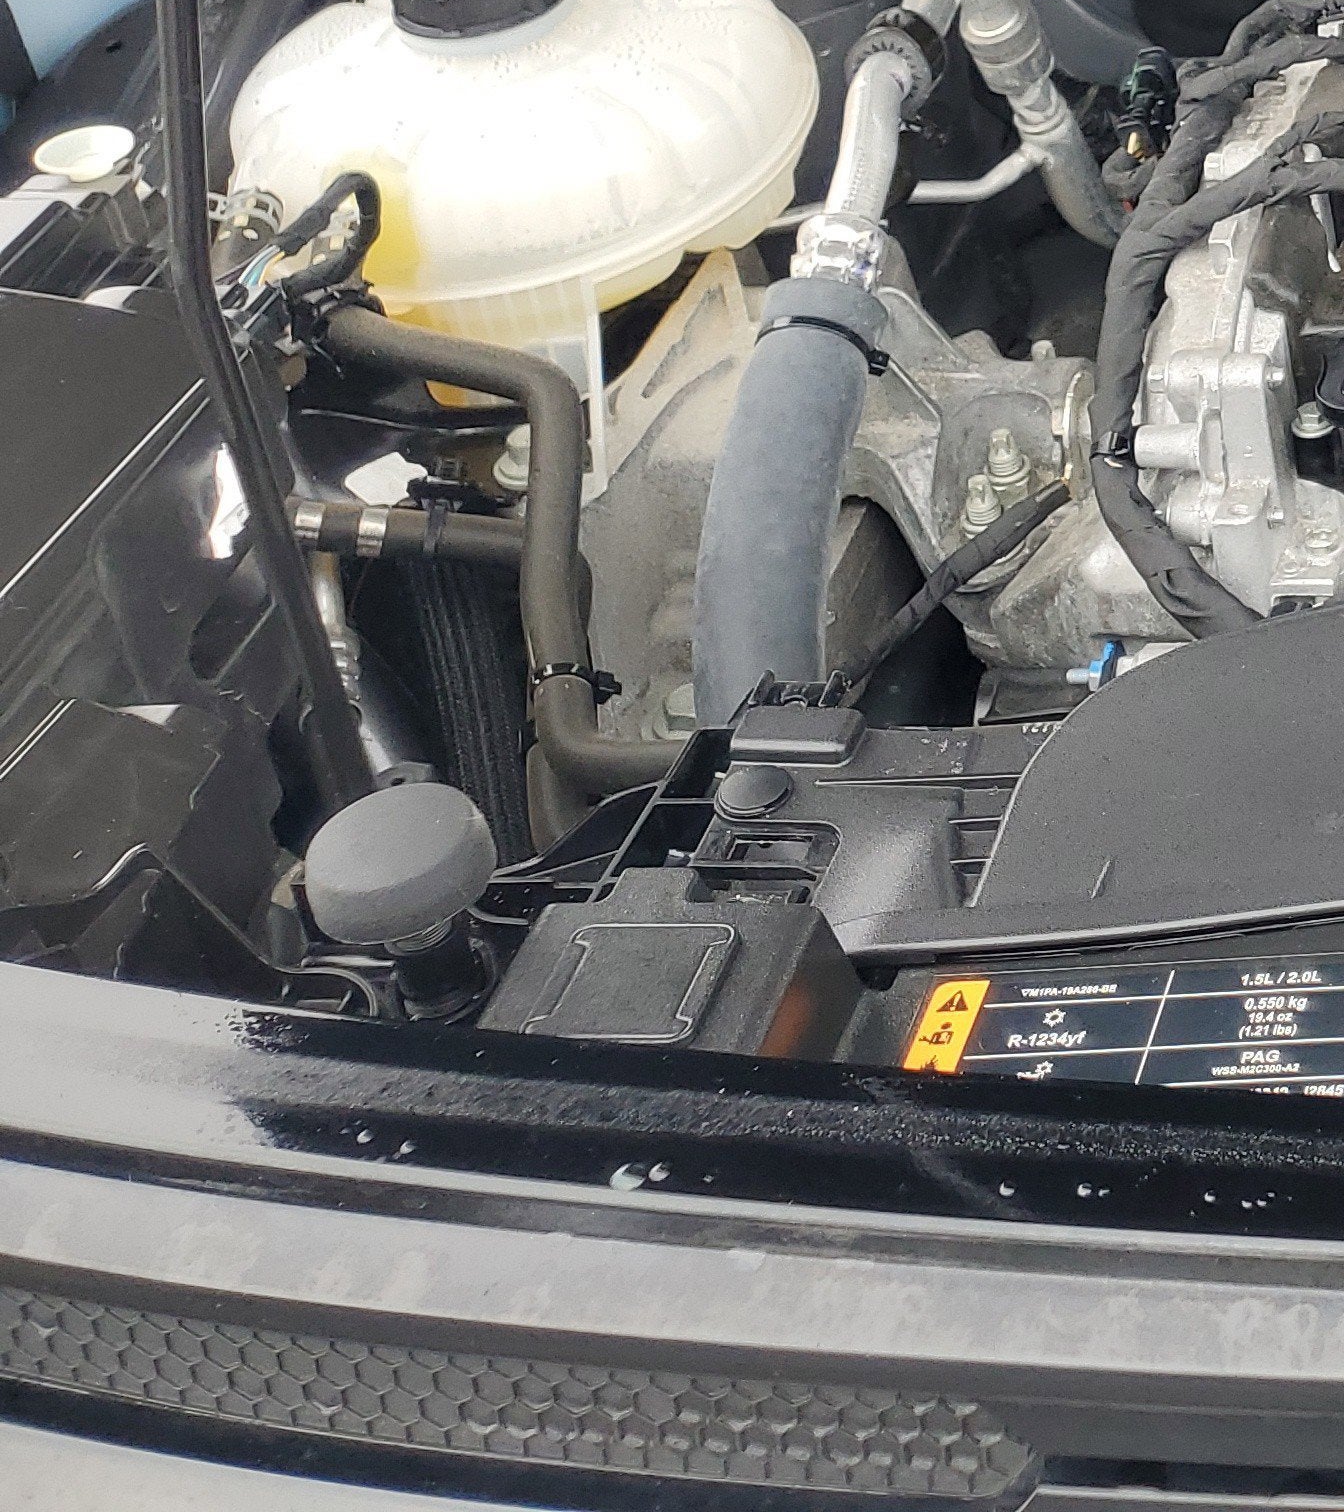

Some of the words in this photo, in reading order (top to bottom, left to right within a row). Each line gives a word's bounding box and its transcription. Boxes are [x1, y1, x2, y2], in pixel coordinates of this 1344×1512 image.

[1240, 972, 1274, 987] 1.5L
[1276, 971, 1286, 985] /
[1286, 970, 1322, 985] 2.0L
[1244, 996, 1285, 1011] 0.550
[1288, 995, 1308, 1012] kg
[1248, 1011, 1277, 1024] 19.4
[1277, 1012, 1294, 1022] oz
[1007, 1030, 1087, 1049] R-1234yf
[1238, 1025, 1270, 1040] (1.21
[1240, 1049, 1281, 1065] PAG
